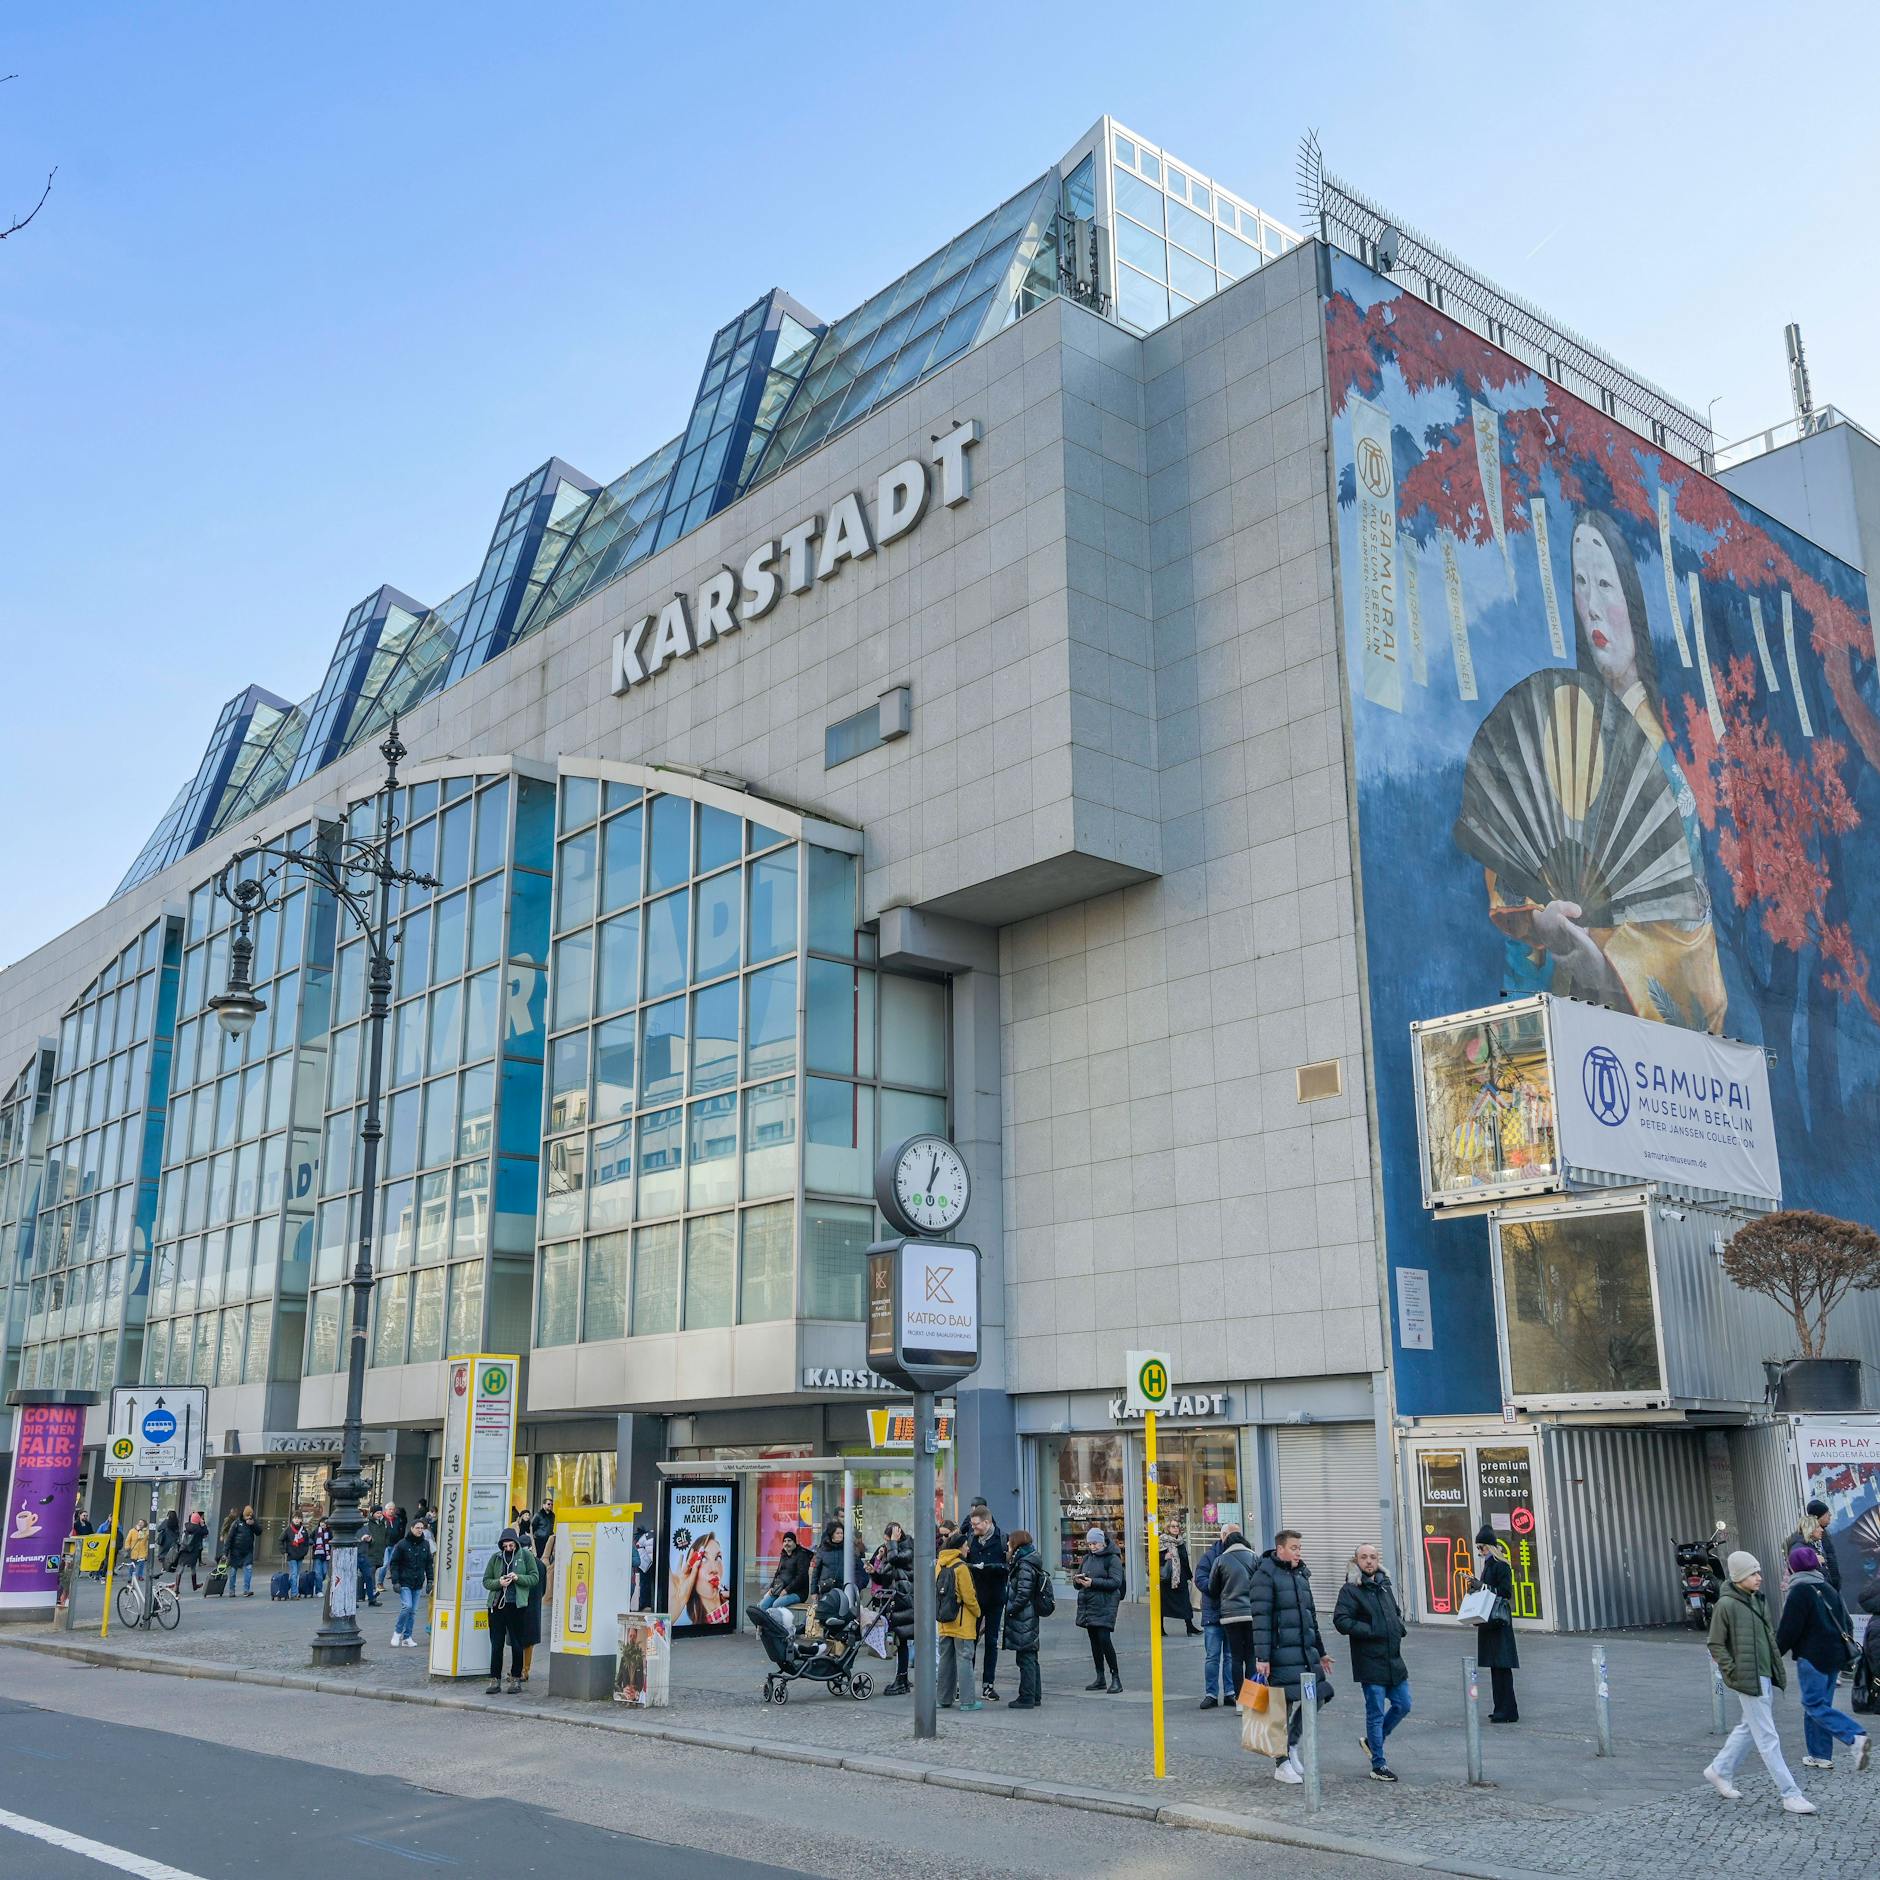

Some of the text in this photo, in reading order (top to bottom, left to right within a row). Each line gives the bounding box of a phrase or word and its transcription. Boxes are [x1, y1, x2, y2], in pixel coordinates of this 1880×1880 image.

[611, 419, 980, 697] KARSTADT
[1379, 510, 1396, 663] SAMURAI
[1371, 589, 1382, 656] BERLIN
[1635, 1061, 1751, 1111] SAMURAI
[1639, 1096, 1753, 1133] MUSEUM BERLIN
[1640, 1118, 1667, 1132] PETER
[1669, 1125, 1705, 1140] JANSSEN
[1643, 1150, 1708, 1169] samuraimuseum.de
[907, 1312, 972, 1328] KATRO BAU
[23, 1424, 44, 1435] DIR
[20, 1436, 75, 1454] FAIR-
[270, 1439, 369, 1452] KARSTAT
[1810, 1438, 1837, 1447] FAIR
[1840, 1438, 1871, 1447] PLAY
[19, 1455, 72, 1468] PRESSO
[1480, 1461, 1528, 1472] premium
[1481, 1475, 1519, 1484] korean
[676, 1493, 727, 1504] ÜBERTRIEBEN
[1482, 1488, 1529, 1498] skincare
[690, 1504, 713, 1513] GUTES
[683, 1514, 719, 1523] MAKE-UP
